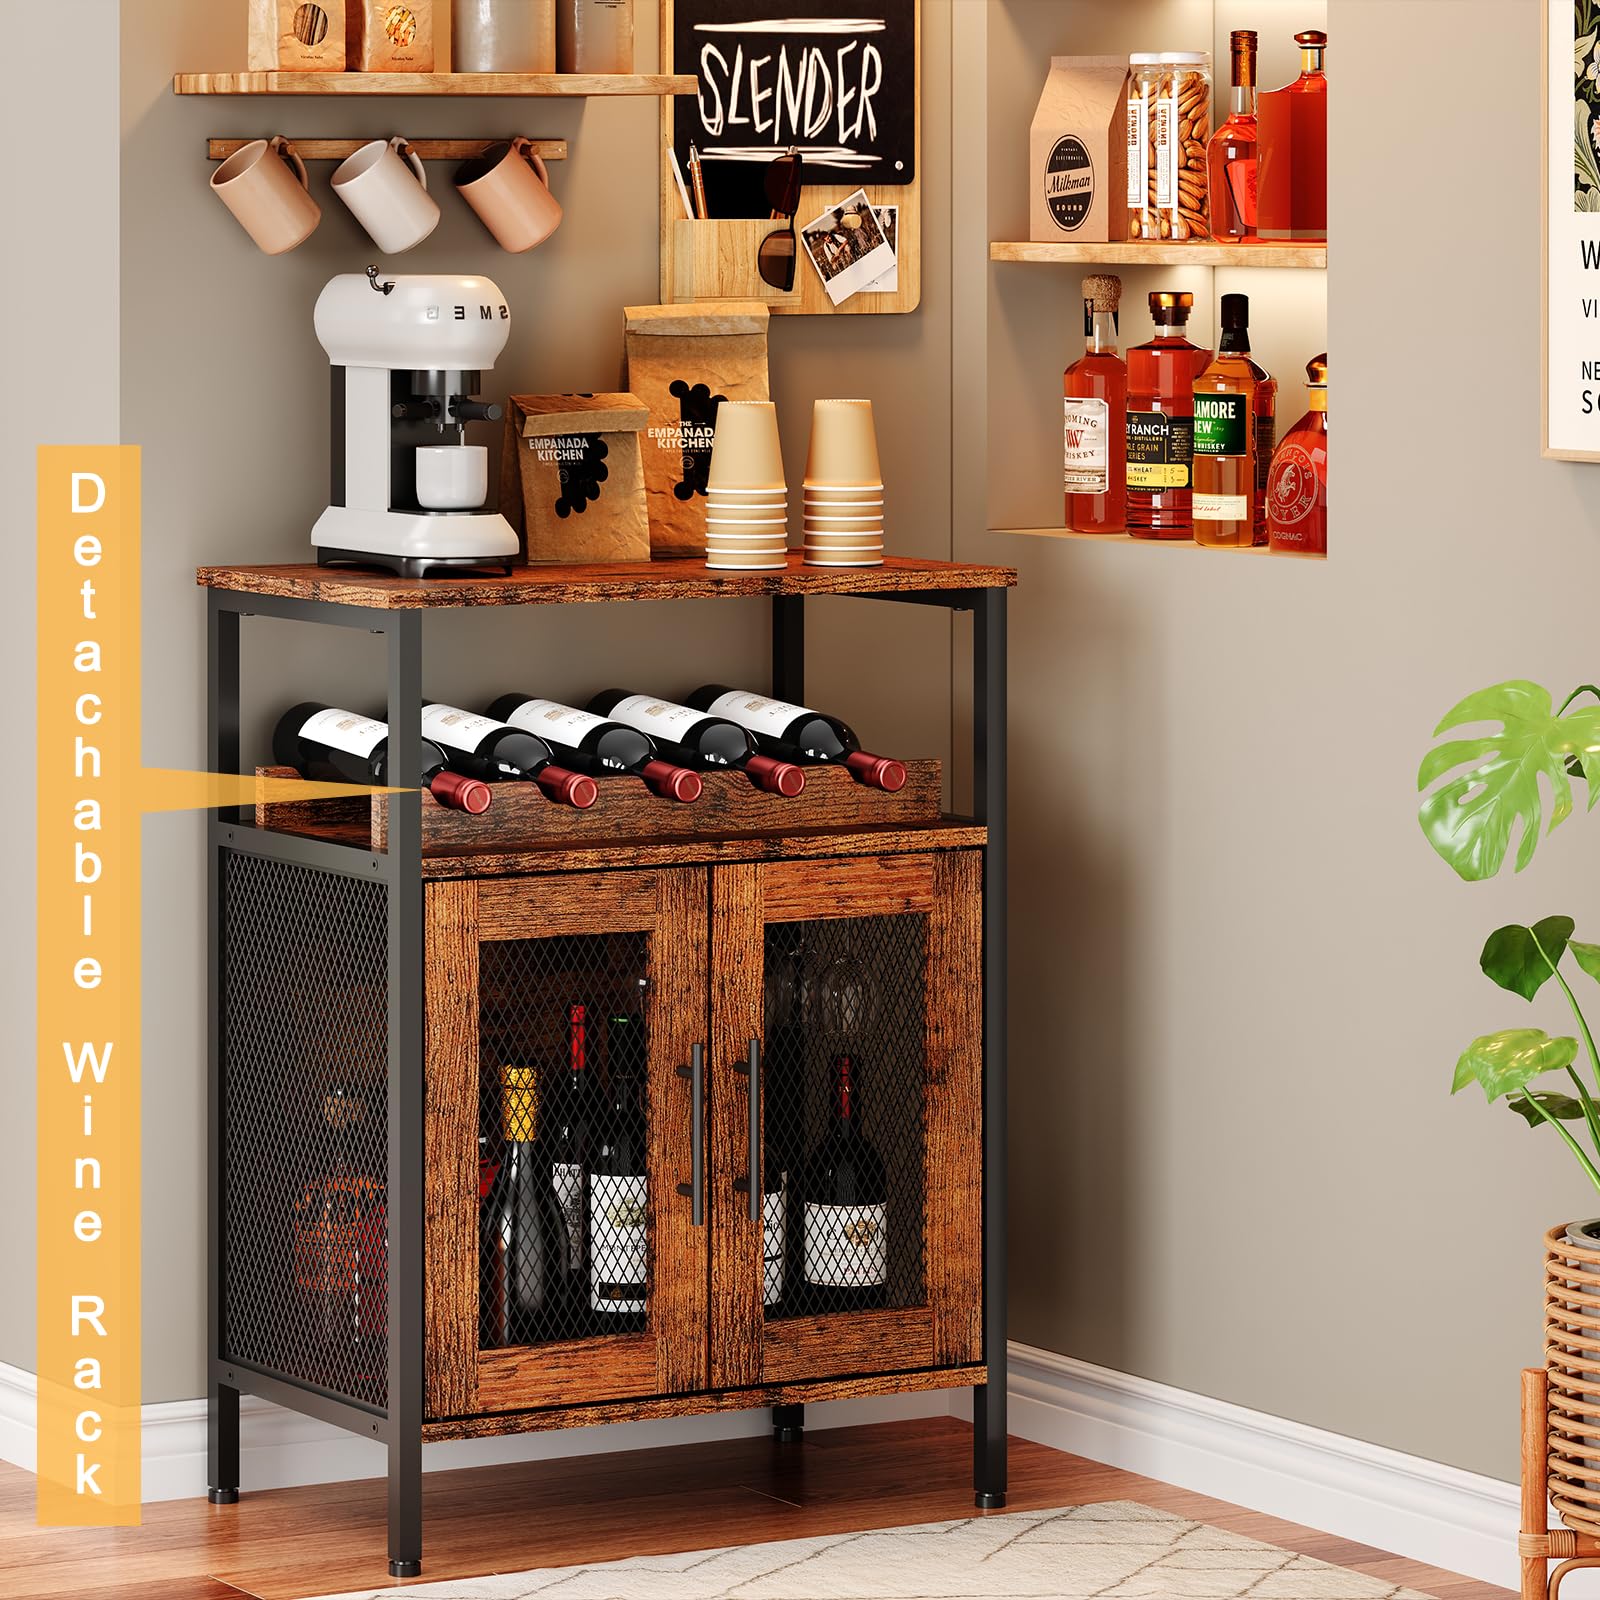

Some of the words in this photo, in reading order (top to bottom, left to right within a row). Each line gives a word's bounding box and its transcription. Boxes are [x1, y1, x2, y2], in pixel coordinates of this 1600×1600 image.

[697, 40, 883, 145] SLENDER
[1047, 173, 1091, 194] Milkman
[1056, 204, 1083, 212] SOUND
[1131, 424, 1169, 436] RANCH
[528, 437, 590, 450] EMPANADA
[657, 438, 716, 449] KITCHEN
[1137, 443, 1159, 452] GRAIN
[537, 449, 584, 461] KITCHEN
[1273, 530, 1303, 541] COGNAC
